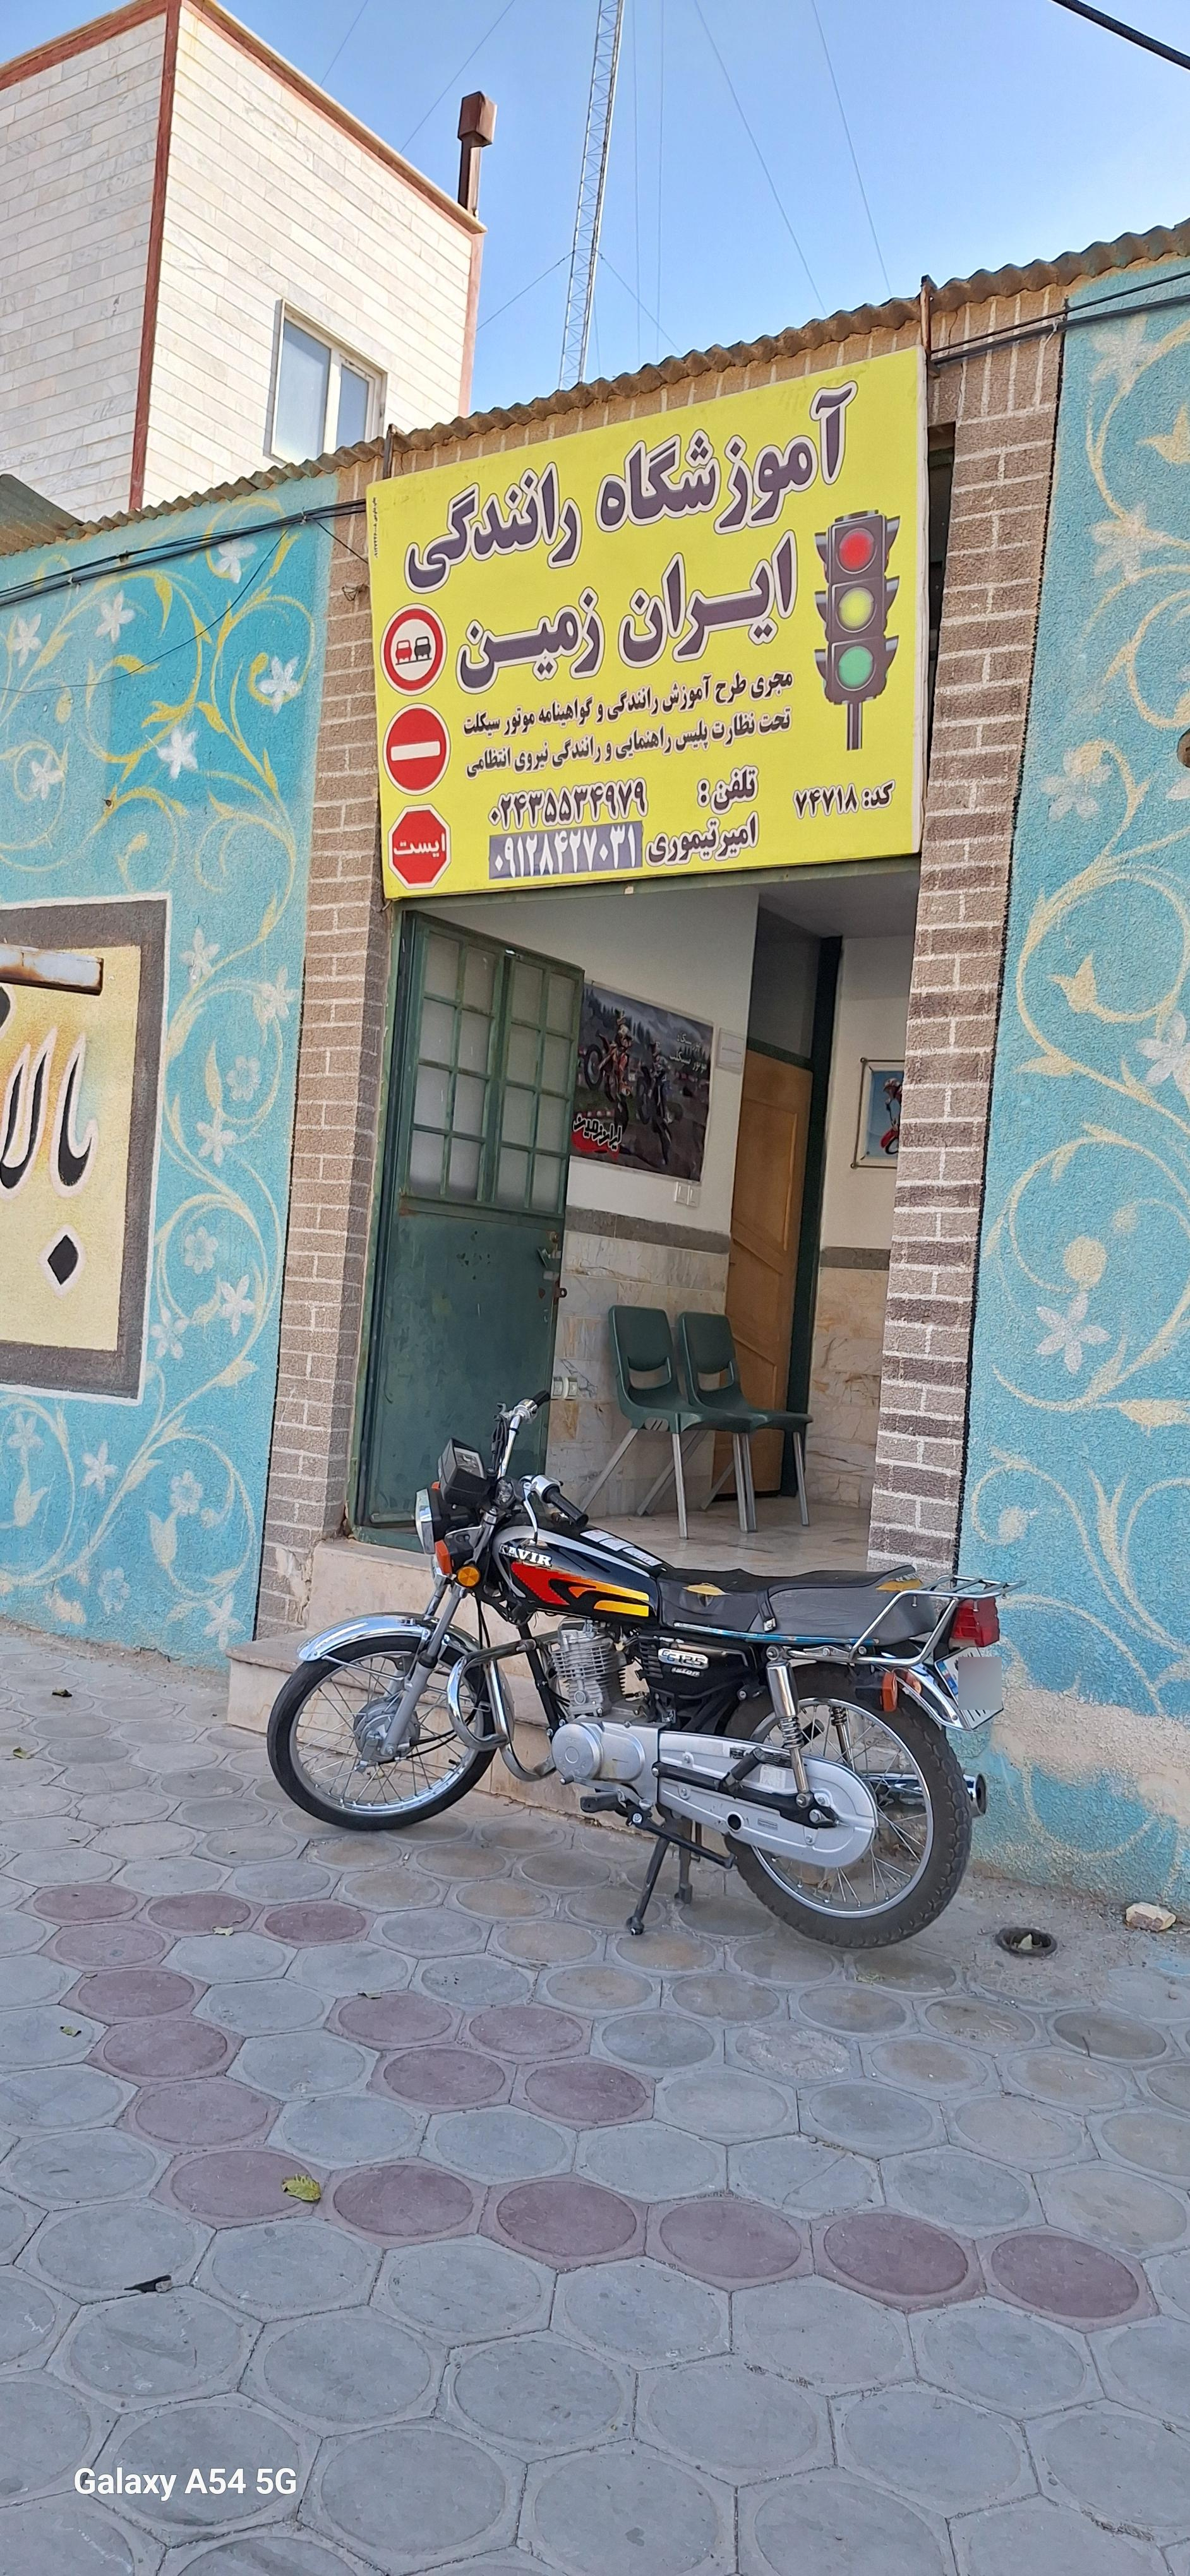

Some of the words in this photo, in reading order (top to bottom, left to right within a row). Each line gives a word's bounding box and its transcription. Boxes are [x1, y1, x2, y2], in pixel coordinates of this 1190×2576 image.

[598, 382, 856, 532] آموزشگاه
[406, 464, 580, 592] رانندگی
[620, 531, 795, 665] ایران
[458, 588, 603, 692] زمین
[663, 675, 712, 712] آموزش
[715, 672, 747, 703] طرح
[750, 671, 793, 698] مجری
[538, 696, 593, 725] گواهینامه
[596, 703, 603, 723] و
[607, 686, 658, 721] رانندگی
[463, 712, 501, 737] سیکلت
[504, 707, 535, 736] موتور
[675, 720, 708, 751] پلیس
[712, 713, 755, 745] نظارت
[759, 708, 791, 734] تحت
[514, 742, 549, 772] نیروی
[552, 736, 601, 767] رانندگی
[604, 742, 611, 761] و
[616, 725, 671, 760] راهنمایی
[467, 746, 511, 778] انتظامی
[490, 780, 646, 830] ۰۲۴۳۵۵۳۴۹۷۹
[793, 784, 858, 818] ۷۴۷۱۸
[863, 780, 895, 809] کد:
[393, 833, 446, 857] ایست
[495, 824, 636, 878] ۰۹۱۲۸۴۲۷۰۳۱
[498, 1544, 552, 1567] KAVIR
